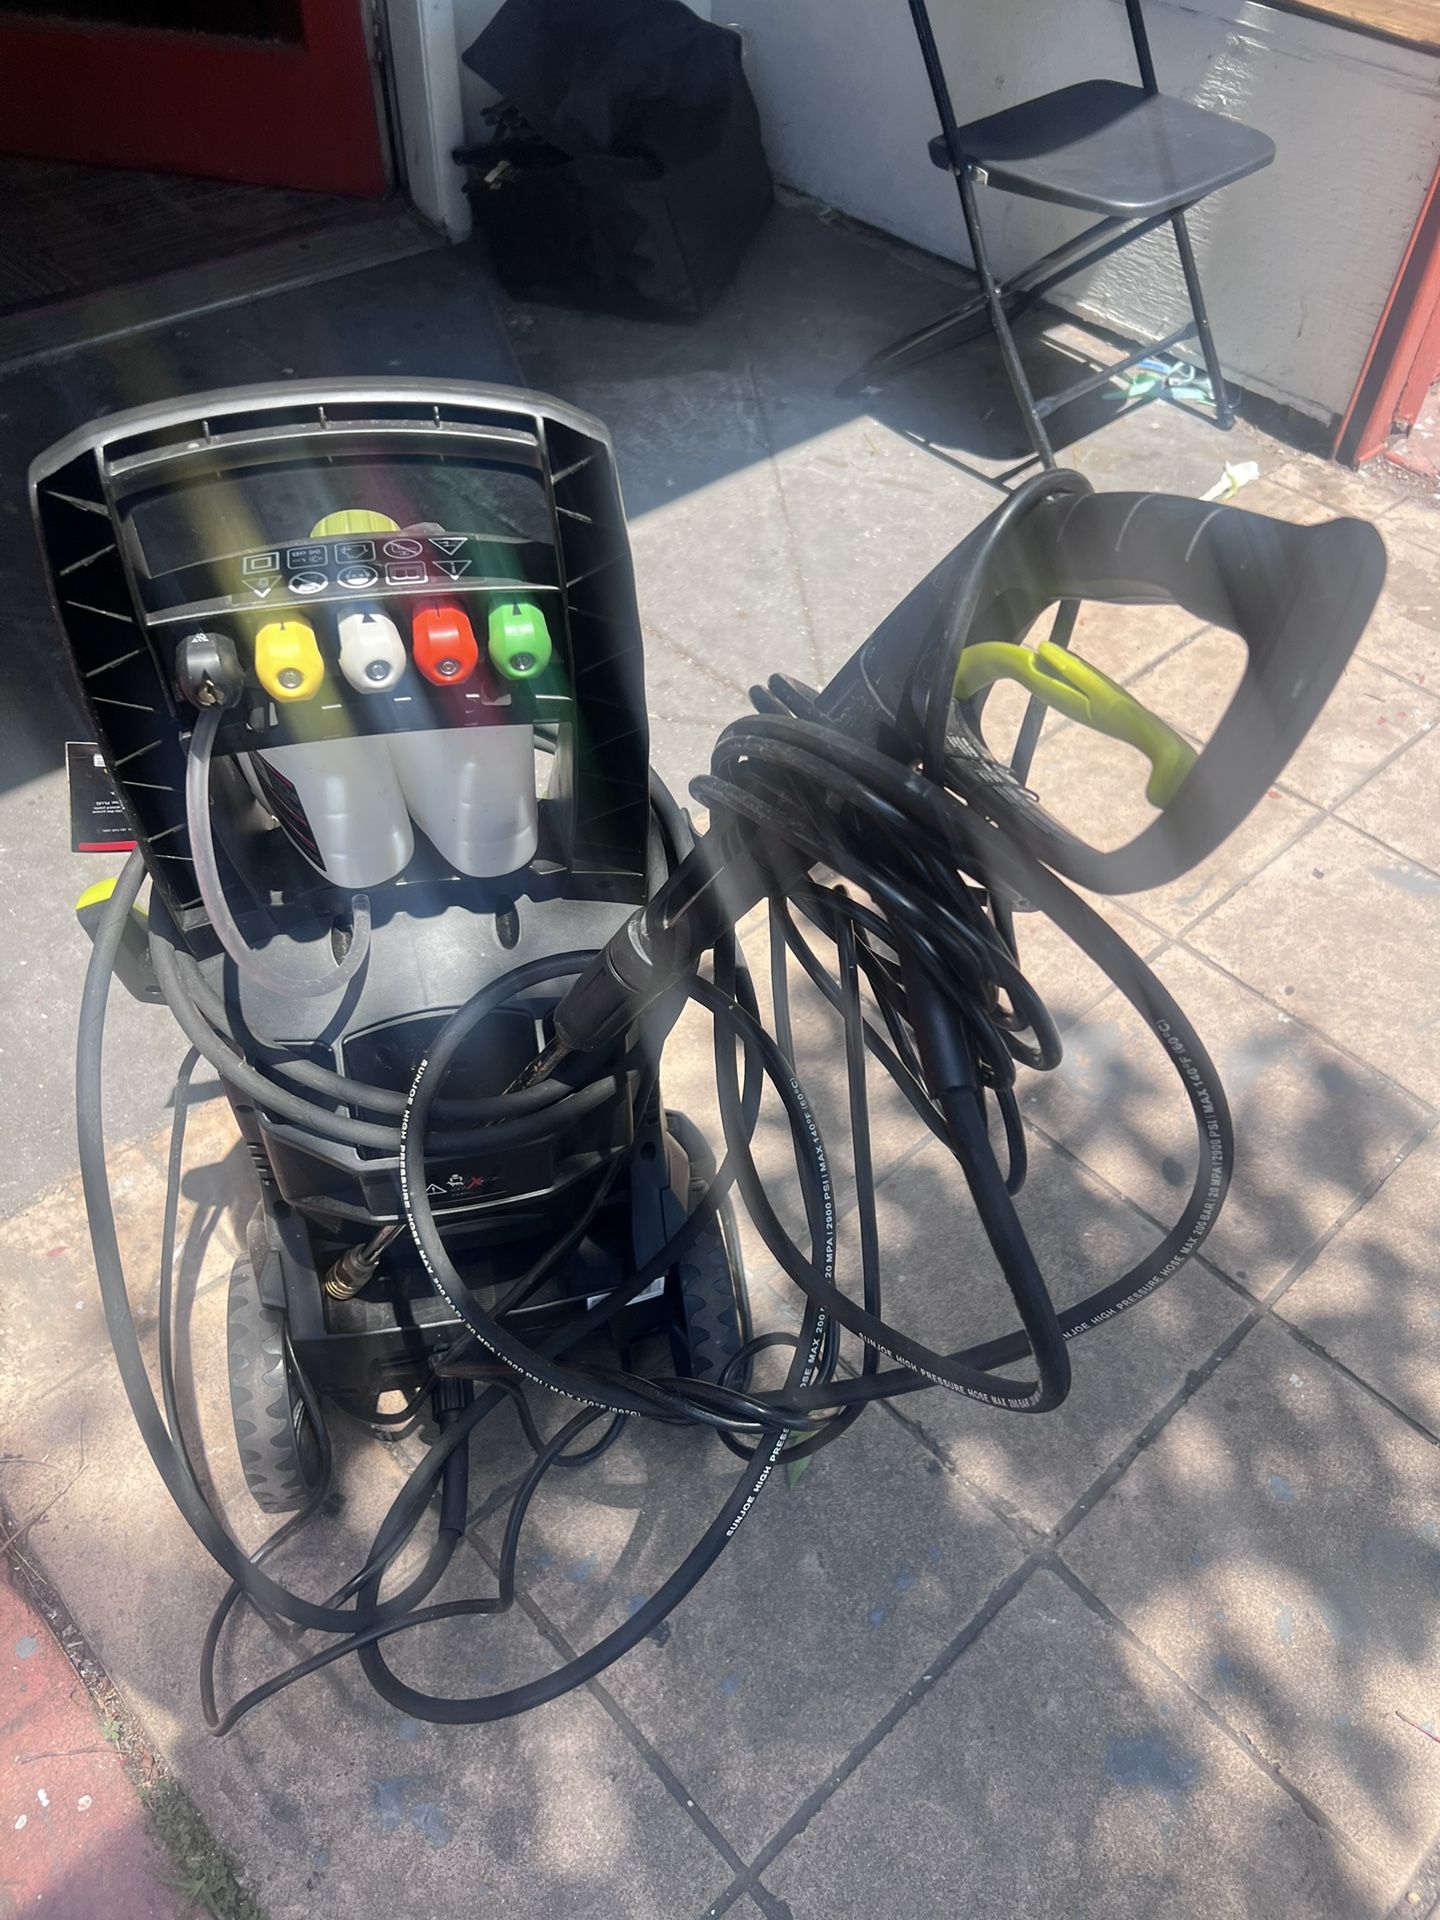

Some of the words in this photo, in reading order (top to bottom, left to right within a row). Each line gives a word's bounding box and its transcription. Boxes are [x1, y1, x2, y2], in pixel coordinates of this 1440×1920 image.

[407, 1059, 428, 1105] SUNJOE
[1197, 1089, 1214, 1113] MAX
[401, 1110, 410, 1139] HIGH
[1208, 1120, 1220, 1137] PSI
[815, 1146, 827, 1172] MAX
[400, 1144, 411, 1208] PRESSURE
[1210, 1166, 1223, 1186] MPA
[822, 1180, 831, 1200] PSI
[1208, 1188, 1219, 1198] 20
[826, 1201, 834, 1229] 2900
[1200, 1202, 1215, 1221] BAR
[407, 1213, 421, 1246] HOSE
[1193, 1221, 1207, 1238] 200
[1180, 1236, 1198, 1255] MAX
[825, 1266, 832, 1278] 20
[1160, 1255, 1184, 1276] HOSE
[1116, 1276, 1162, 1310] PRESSURE
[816, 1313, 826, 1334] 200
[1091, 1308, 1116, 1325] HIGH
[808, 1338, 820, 1364] MAX
[858, 1332, 892, 1357] SUNJOE
[896, 1354, 918, 1372] HIGH
[920, 1368, 965, 1395] PRESSURE
[753, 1466, 772, 1492] HIGH
[726, 1496, 755, 1536] SUNJOE
